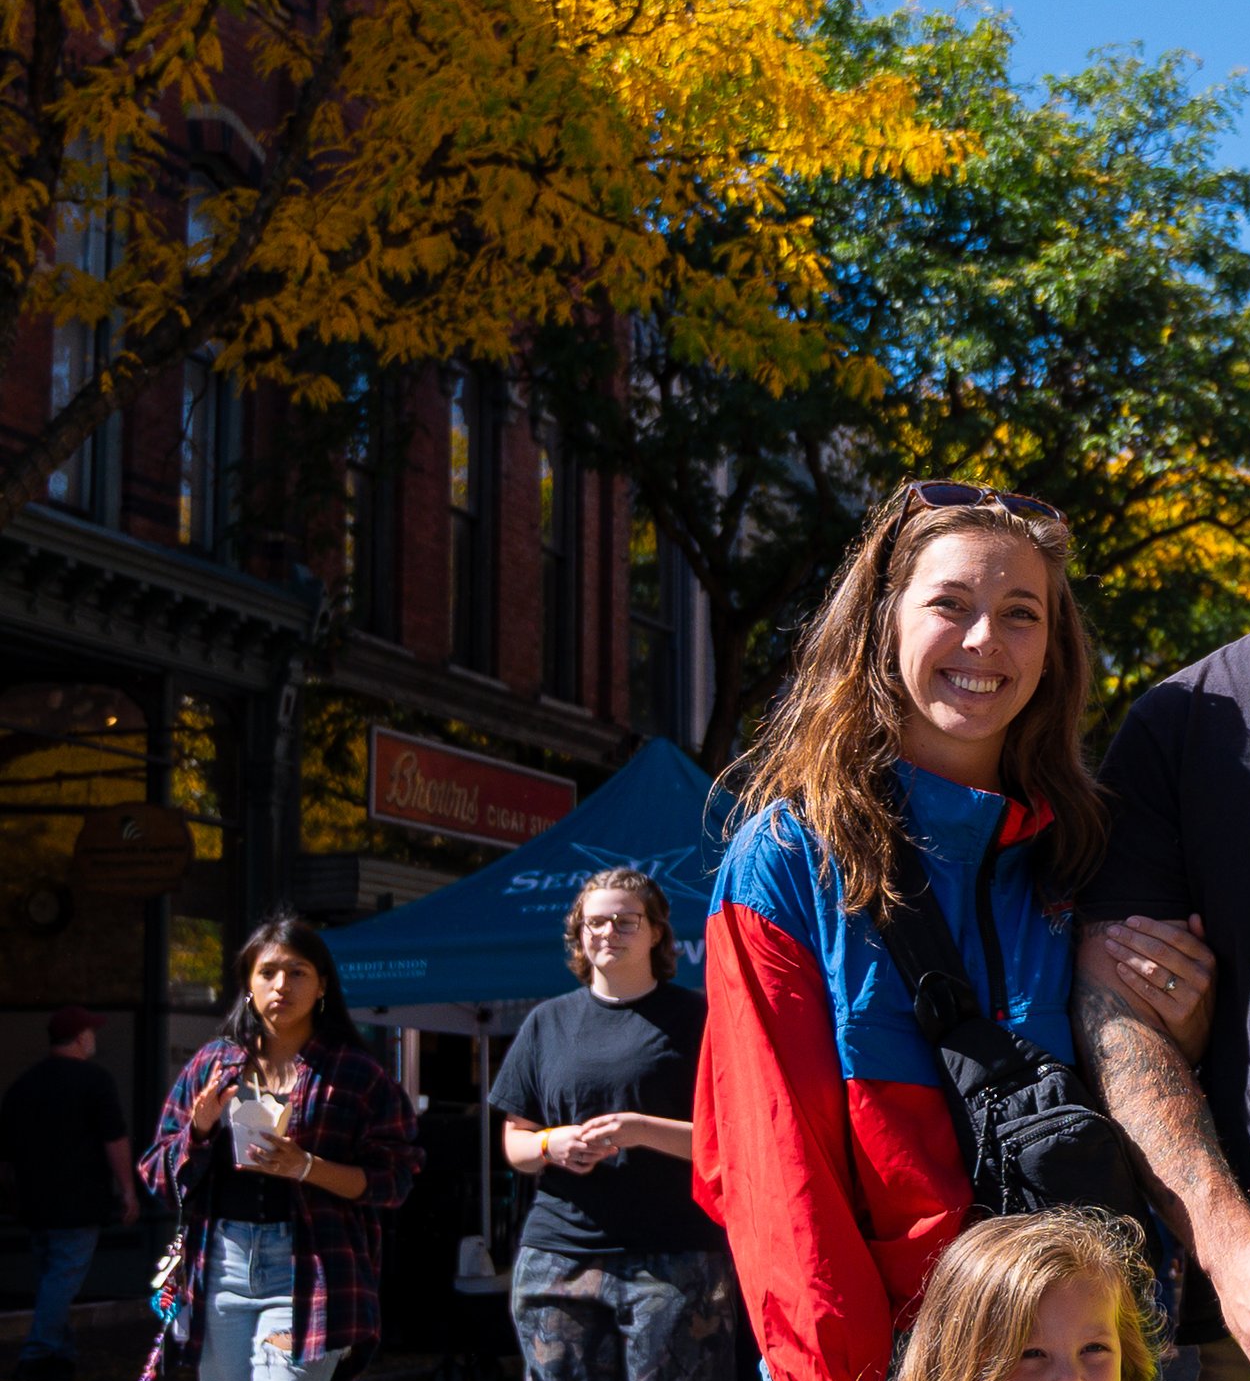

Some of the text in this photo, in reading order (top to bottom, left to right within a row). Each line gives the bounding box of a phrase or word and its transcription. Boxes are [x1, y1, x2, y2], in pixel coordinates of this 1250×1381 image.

[486, 804, 527, 834] CIGAR
[339, 959, 429, 972] CREDIT UNION
